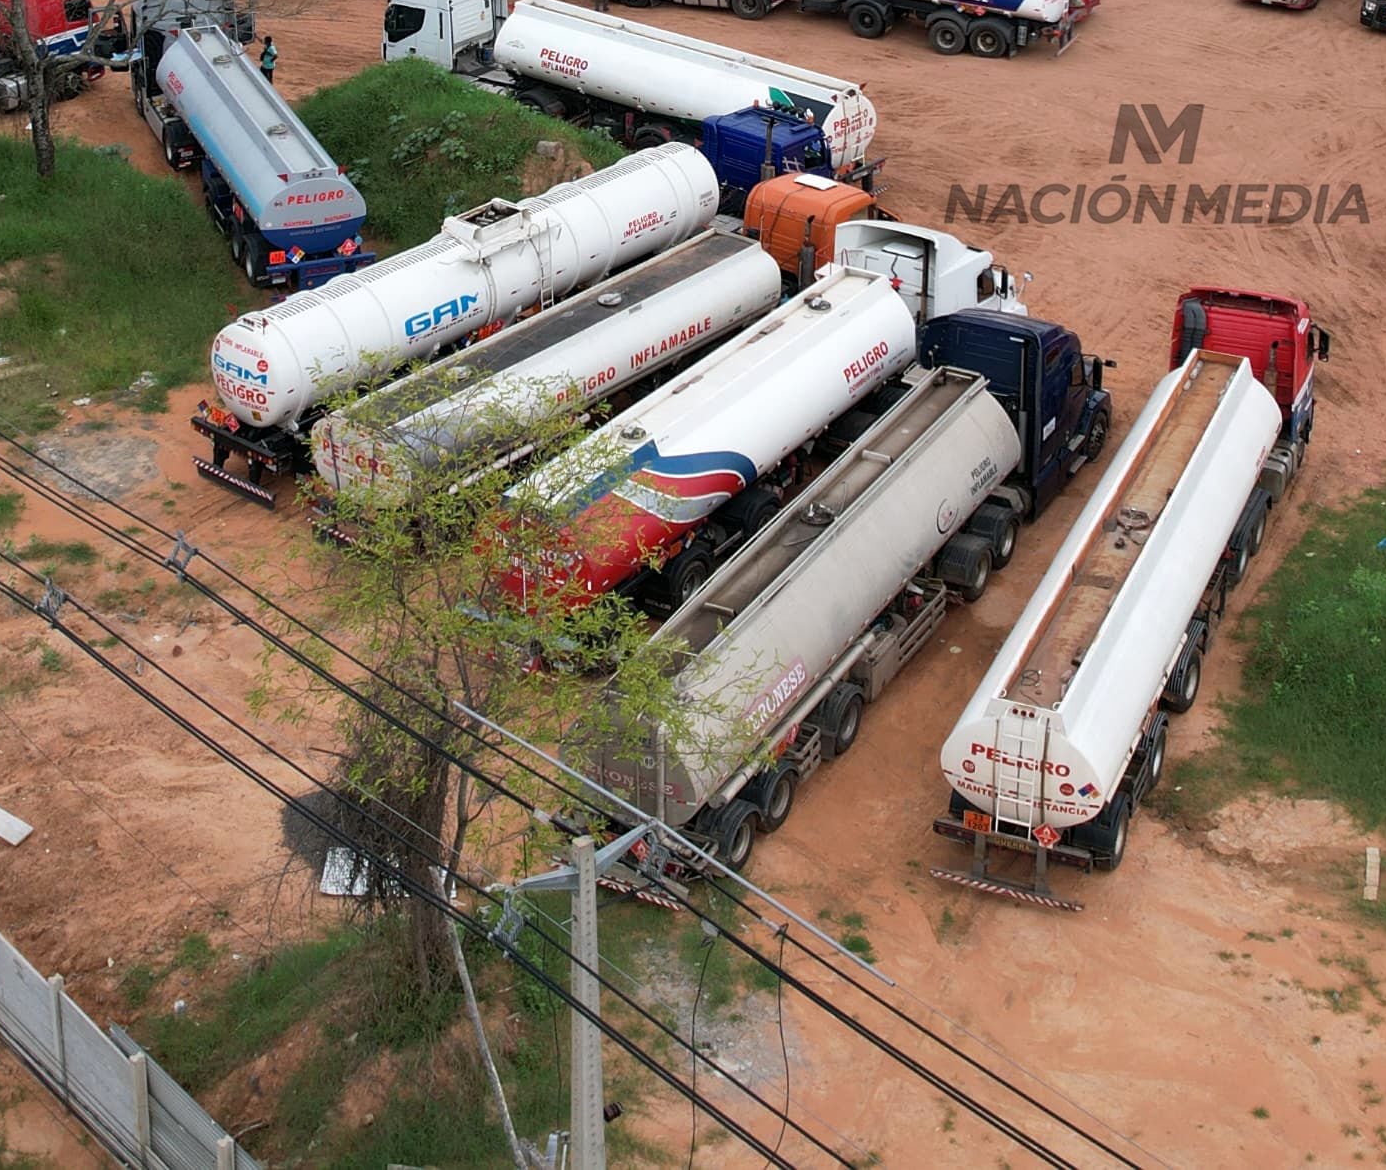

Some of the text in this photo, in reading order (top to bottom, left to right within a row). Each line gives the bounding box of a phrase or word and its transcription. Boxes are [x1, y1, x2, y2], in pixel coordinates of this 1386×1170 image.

[540, 47, 589, 71] PELIGRO
[541, 60, 581, 79] INFLAMABLE
[287, 189, 344, 206] PELIGRO
[623, 215, 663, 239] INFLAMABLE
[628, 210, 659, 228] PELIGRO
[630, 317, 712, 369] INFLAMABLE
[214, 353, 268, 385] GAM
[843, 341, 889, 382] PELIGRO
[216, 373, 267, 405] PELIGRO
[970, 455, 991, 479] PELIGRO
[970, 464, 998, 495] INFLAMABLE
[971, 742, 1070, 777] PELIGRO
